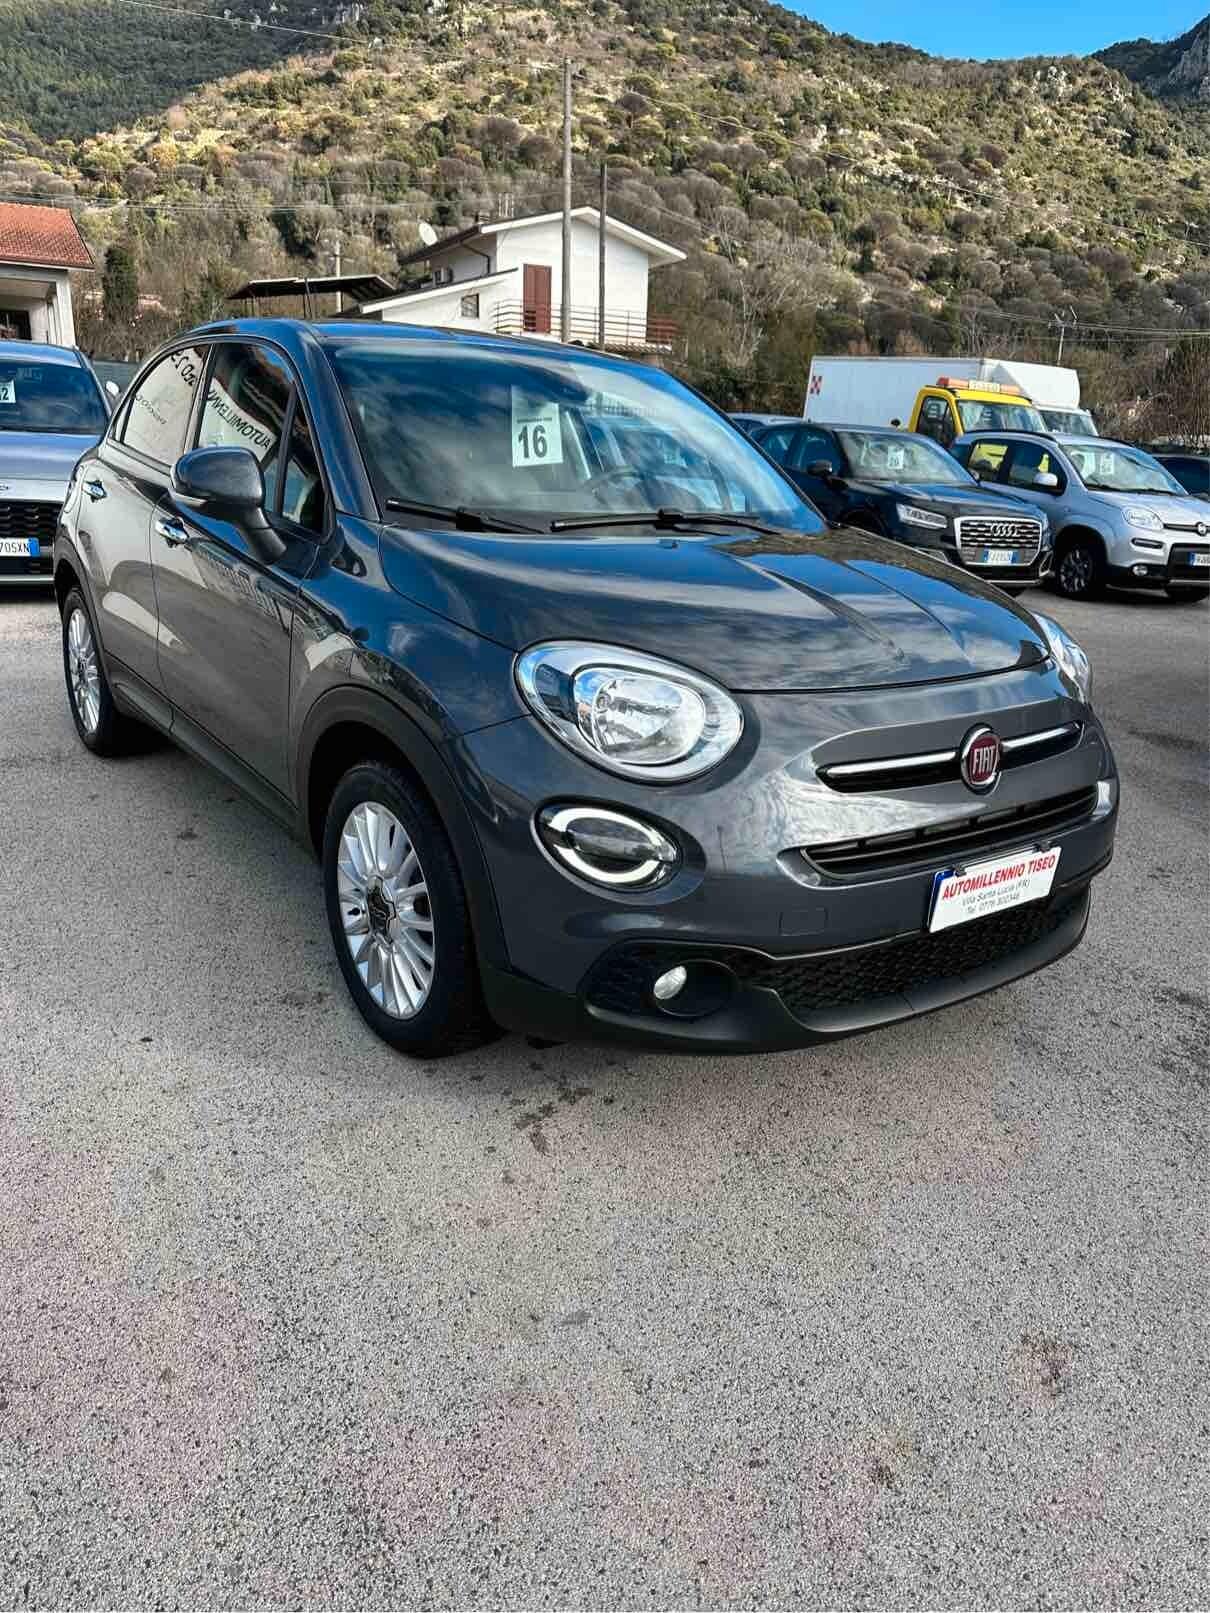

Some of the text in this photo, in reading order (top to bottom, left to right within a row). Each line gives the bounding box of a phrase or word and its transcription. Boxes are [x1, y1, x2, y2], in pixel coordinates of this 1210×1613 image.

[518, 424, 548, 459] 16
[972, 745, 996, 775] FIAT
[942, 855, 1056, 899] AUTOMILLENNIO TISEO
